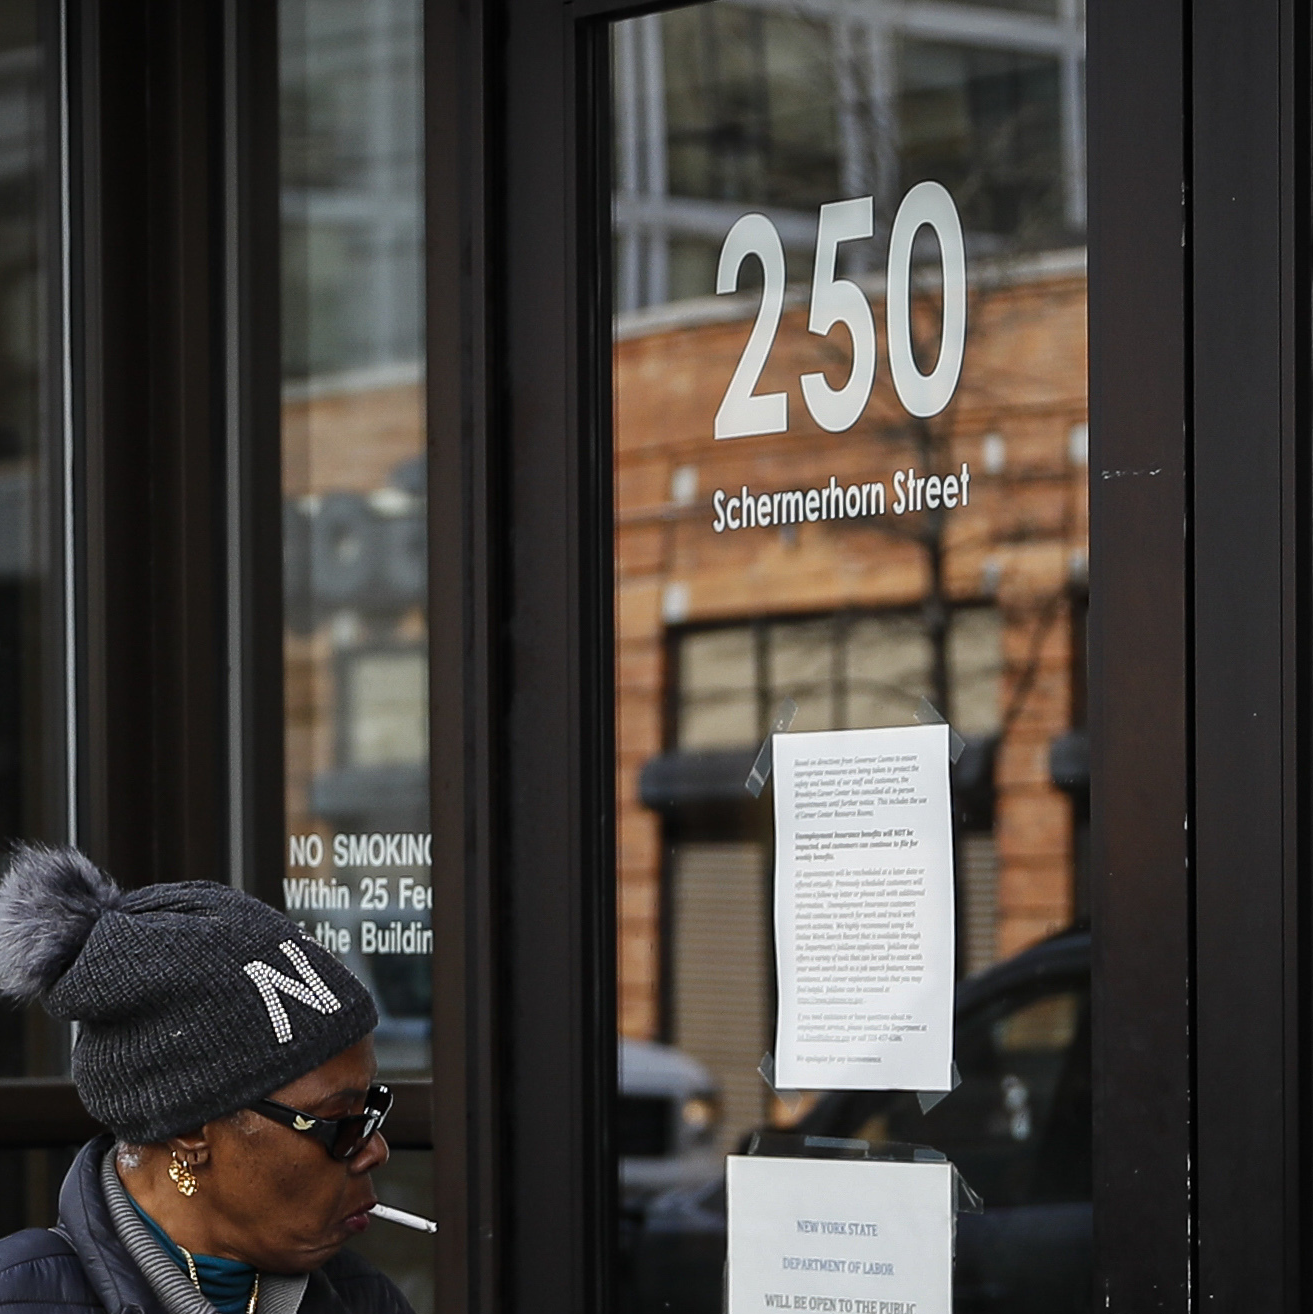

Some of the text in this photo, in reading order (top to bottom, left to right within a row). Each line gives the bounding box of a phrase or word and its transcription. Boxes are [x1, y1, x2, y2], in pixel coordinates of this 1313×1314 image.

[714, 179, 967, 440] 250
[712, 463, 970, 533] Schermerhorn Street
[289, 834, 323, 867] NO
[283, 878, 350, 910] Within
[360, 878, 388, 910] 25
[243, 938, 341, 1044] N
[797, 1220, 878, 1236] NEW YORK STATE
[782, 1258, 894, 1276] DEPARTMENT OF LABOR
[765, 1294, 793, 1309] WILL
[794, 1295, 808, 1309] BE
[809, 1296, 837, 1312] OPEN
[838, 1298, 852, 1312] TO
[855, 1300, 877, 1314] THE
